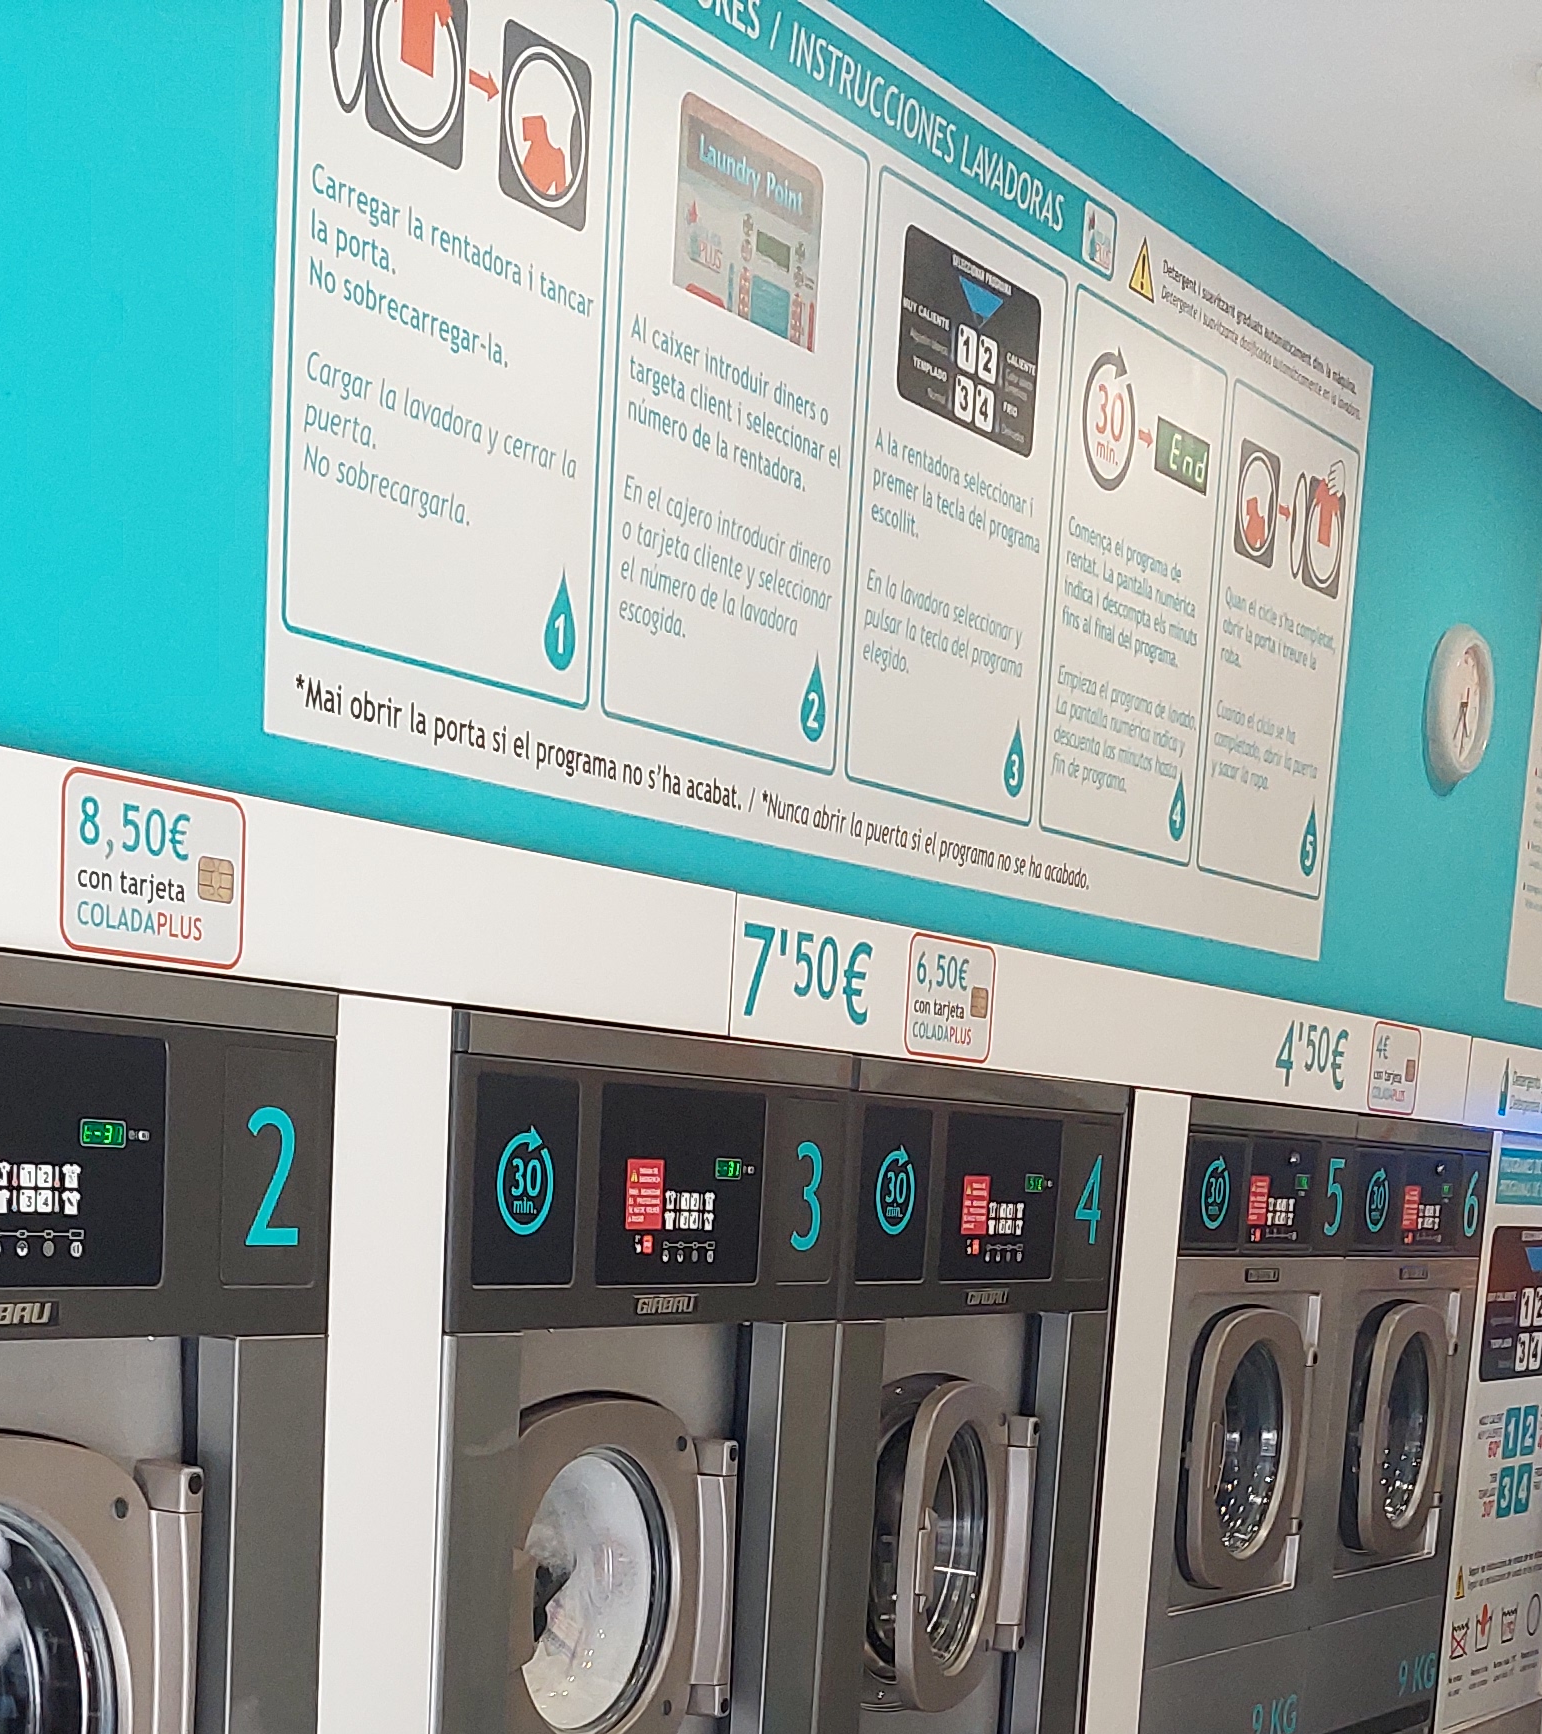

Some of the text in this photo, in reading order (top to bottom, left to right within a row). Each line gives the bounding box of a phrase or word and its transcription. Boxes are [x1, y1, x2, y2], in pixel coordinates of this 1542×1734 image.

[789, 22, 1064, 231] INSTRUCCIONES LAVADORAS
[312, 210, 396, 275] la porta.
[313, 164, 594, 317] Carregar la rentadora i tancar
[310, 256, 507, 368] No sobrecarregar-la.
[628, 400, 805, 492] número de la rentadora.
[351, 691, 402, 728] obrir
[411, 702, 426, 735] la
[434, 717, 485, 749] porta
[493, 726, 506, 754] si
[514, 731, 529, 760] el
[536, 742, 616, 780] programa
[623, 764, 642, 785] no
[648, 764, 680, 796] s'ha
[687, 778, 741, 810] acabat.
[80, 796, 190, 861] 8,50€
[78, 870, 185, 904] con tarjeta
[78, 901, 202, 941] COLADAPLUS
[744, 922, 873, 1025] 7'50€
[916, 952, 969, 992] 6,50€
[913, 1022, 971, 1045] COLADAPLUS
[914, 999, 964, 1021] con tarjeta
[1276, 1020, 1349, 1090] 4'50€
[244, 1106, 299, 1247] 2
[512, 1159, 541, 1200] 30
[514, 1197, 536, 1214] min.
[790, 1140, 823, 1251] 3
[885, 1173, 906, 1206] 30
[1074, 1154, 1103, 1245] 4
[1323, 1157, 1345, 1237] 5
[1463, 1171, 1479, 1238] 6
[1398, 1660, 1408, 1697] 9
[1413, 1653, 1438, 1691] KG
